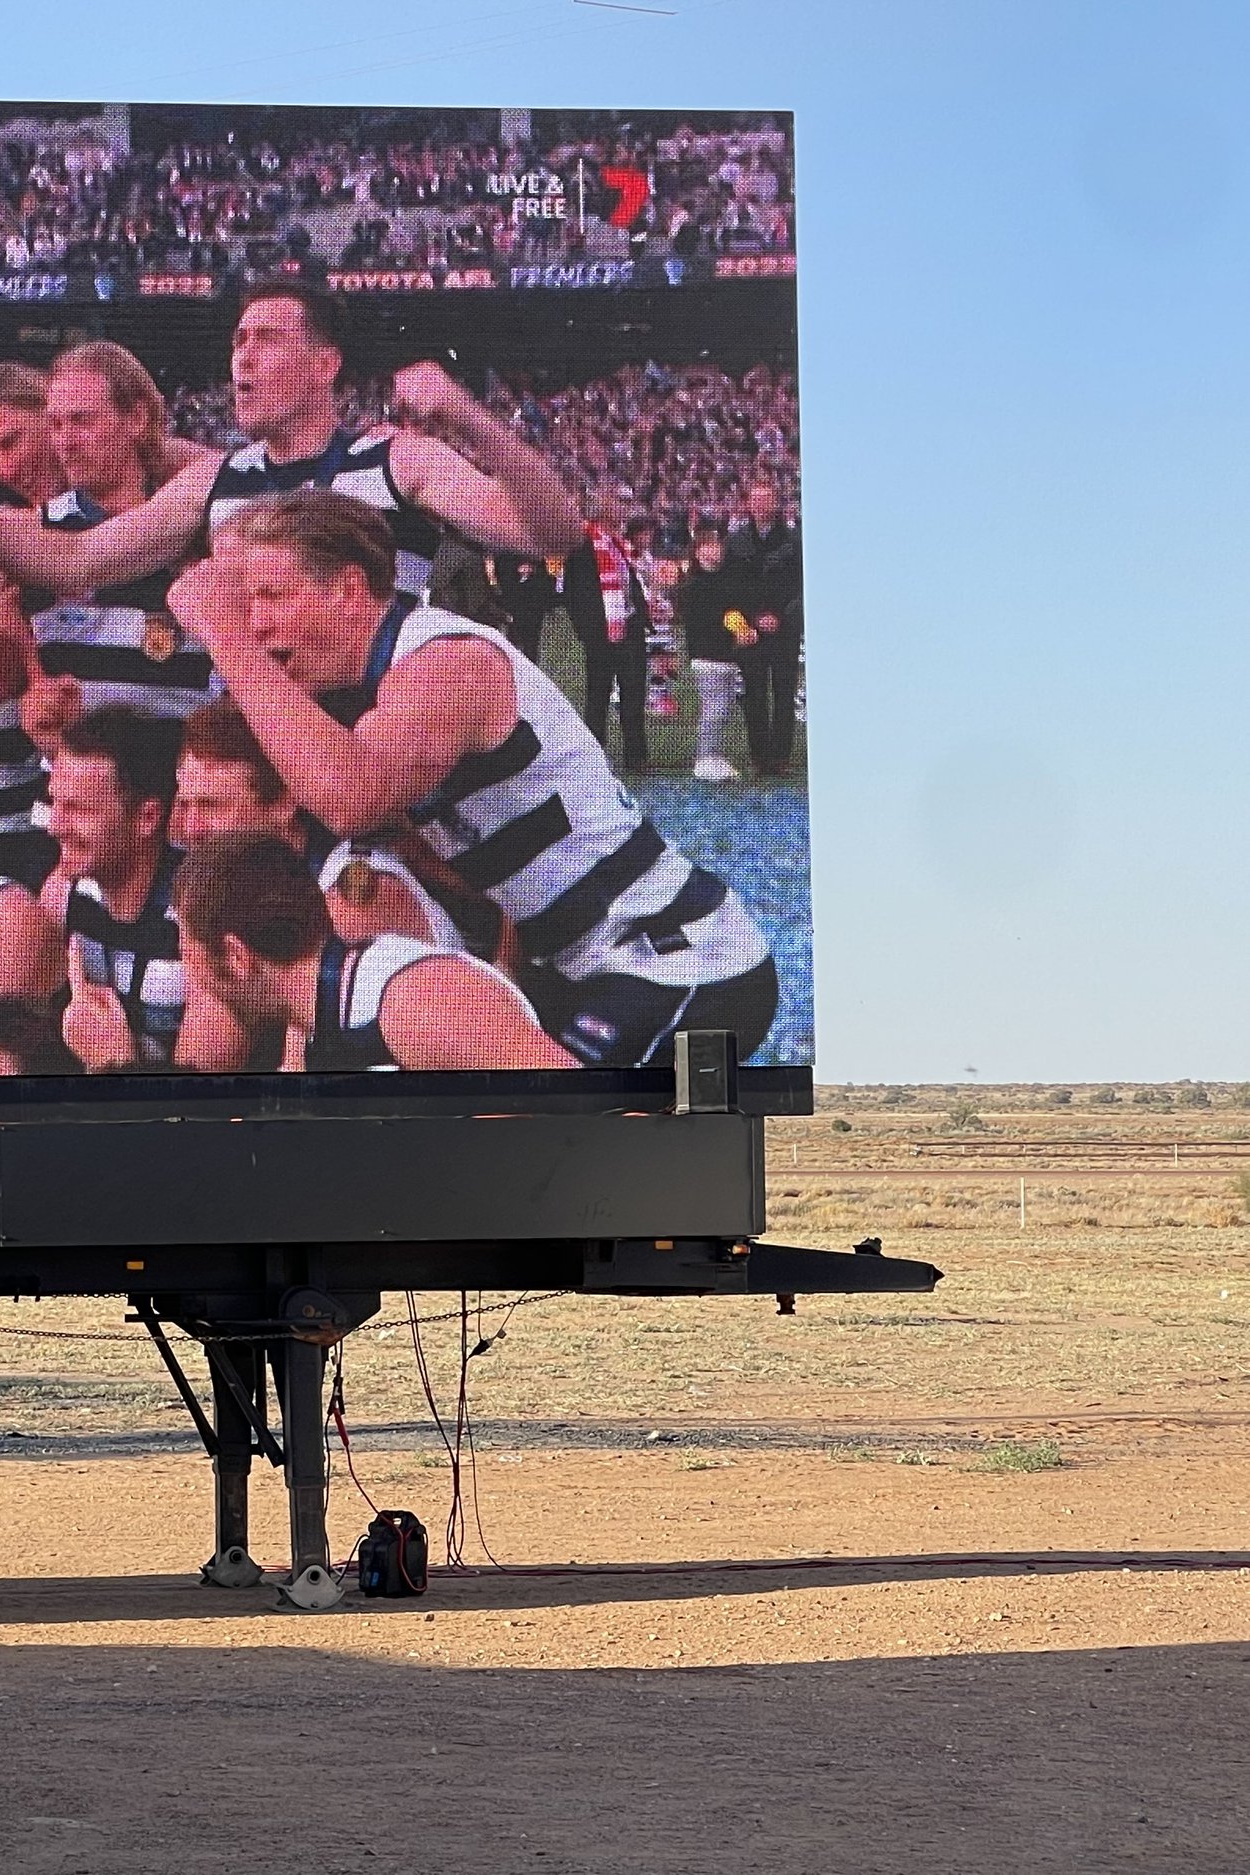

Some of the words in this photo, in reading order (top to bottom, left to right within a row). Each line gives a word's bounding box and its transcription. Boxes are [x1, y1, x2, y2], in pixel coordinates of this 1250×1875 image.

[486, 173, 539, 194] LIVE
[511, 198, 567, 219] FREE
[326, 271, 435, 291] TOYOTA
